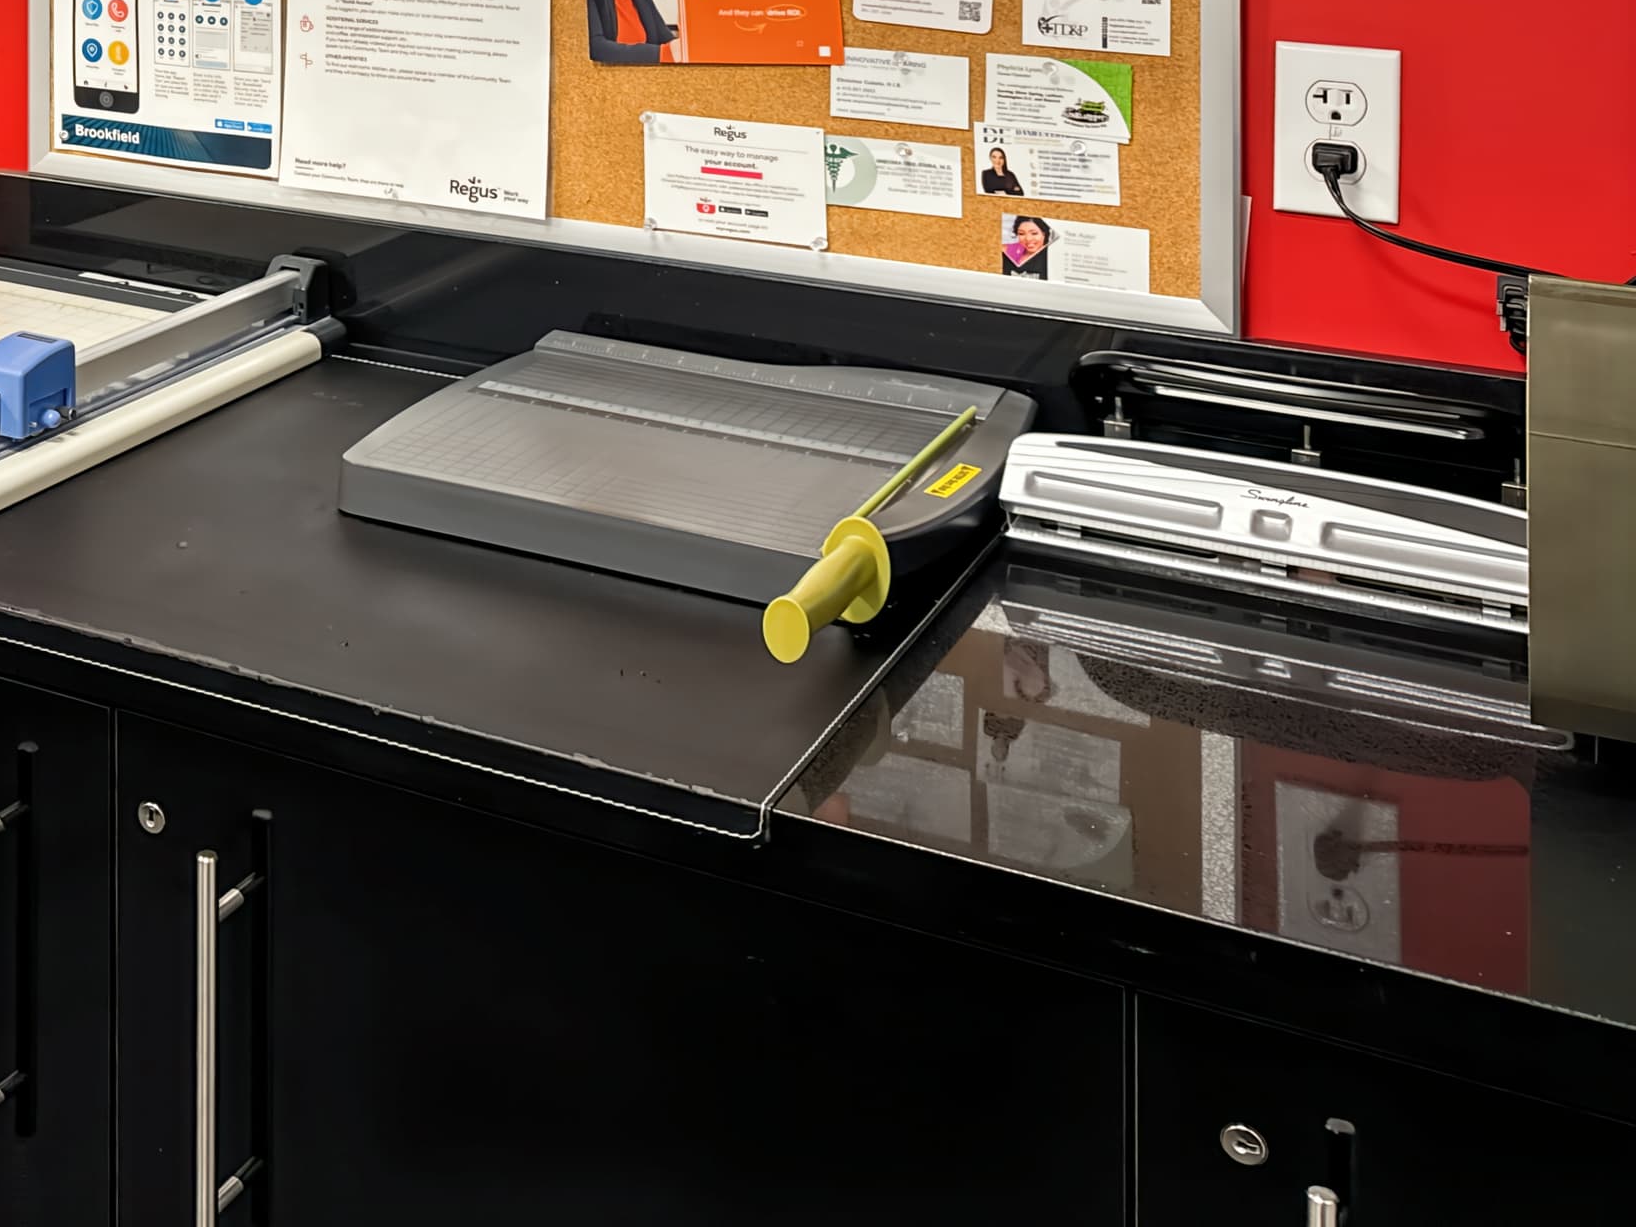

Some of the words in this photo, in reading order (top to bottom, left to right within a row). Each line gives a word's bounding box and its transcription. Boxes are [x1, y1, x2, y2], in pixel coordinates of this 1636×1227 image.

[75, 123, 140, 145] Brookfield
[714, 126, 747, 141] Regus
[685, 145, 699, 153] The
[701, 148, 718, 157] easy
[746, 152, 778, 162] manage
[704, 158, 722, 166] your
[449, 178, 498, 203] Regus
